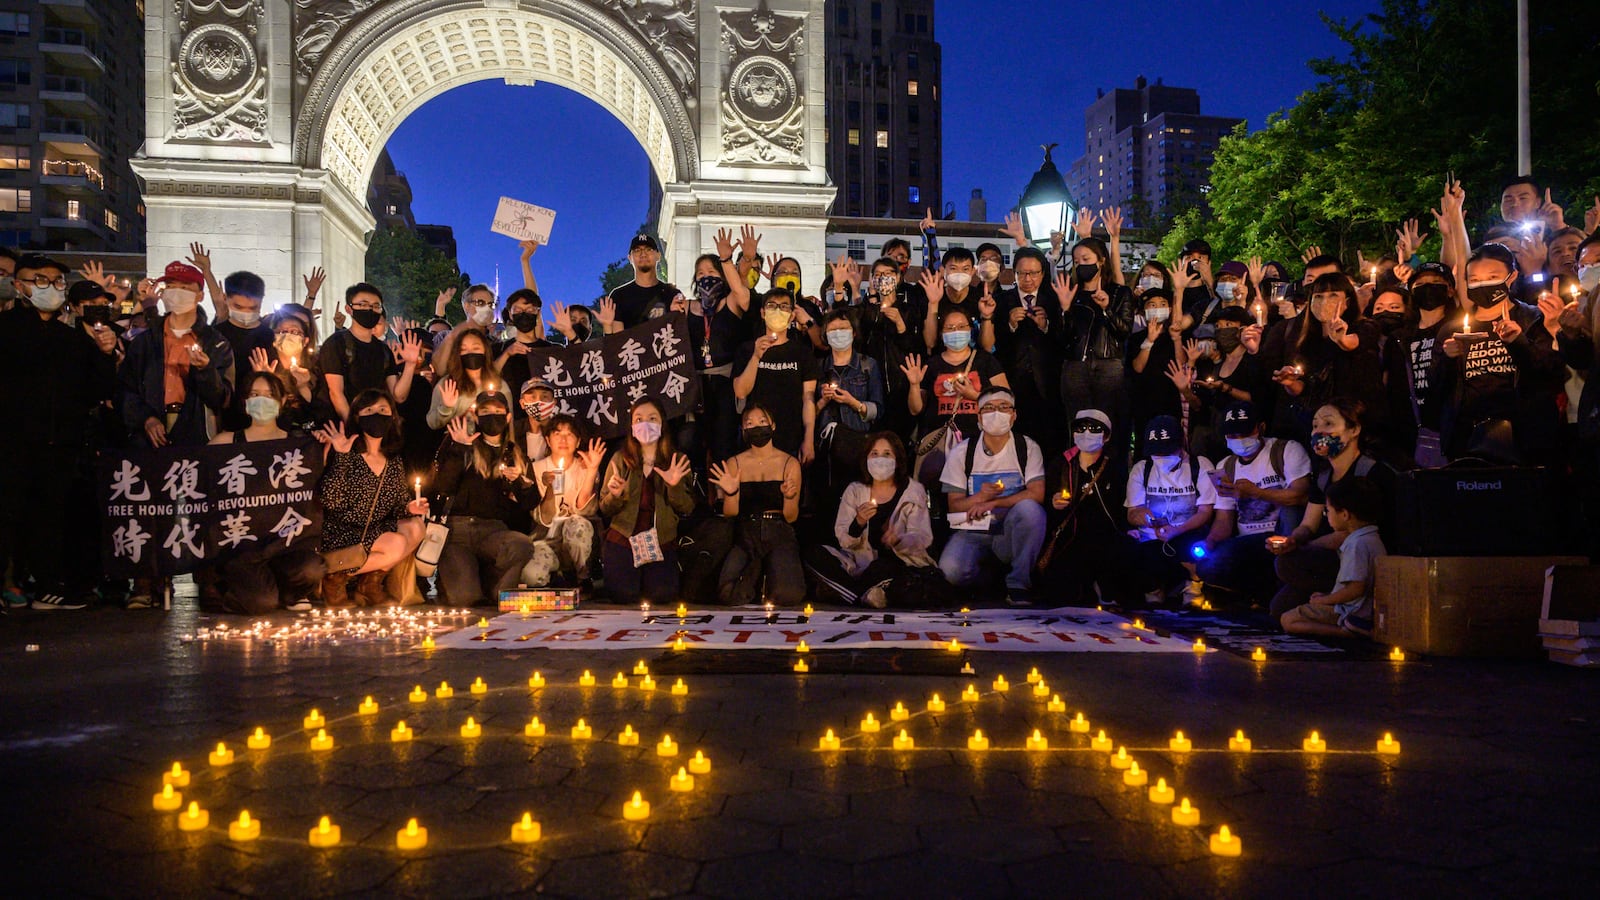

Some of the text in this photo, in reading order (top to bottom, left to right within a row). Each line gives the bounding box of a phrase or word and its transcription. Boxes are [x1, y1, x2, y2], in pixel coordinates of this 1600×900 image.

[542, 323, 682, 387] 光復香港
[1465, 358, 1490, 370] AND
[1467, 346, 1508, 360] EEDOM
[554, 354, 686, 398] EE HONG KONG REVOLUTION NOW
[940, 402, 976, 410] REIST
[108, 448, 312, 501] 光復香港
[1456, 480, 1502, 490] Roland
[108, 490, 313, 517] FREE HONG KONG REVOLUTION NOW
[112, 506, 312, 564] 時代革命
